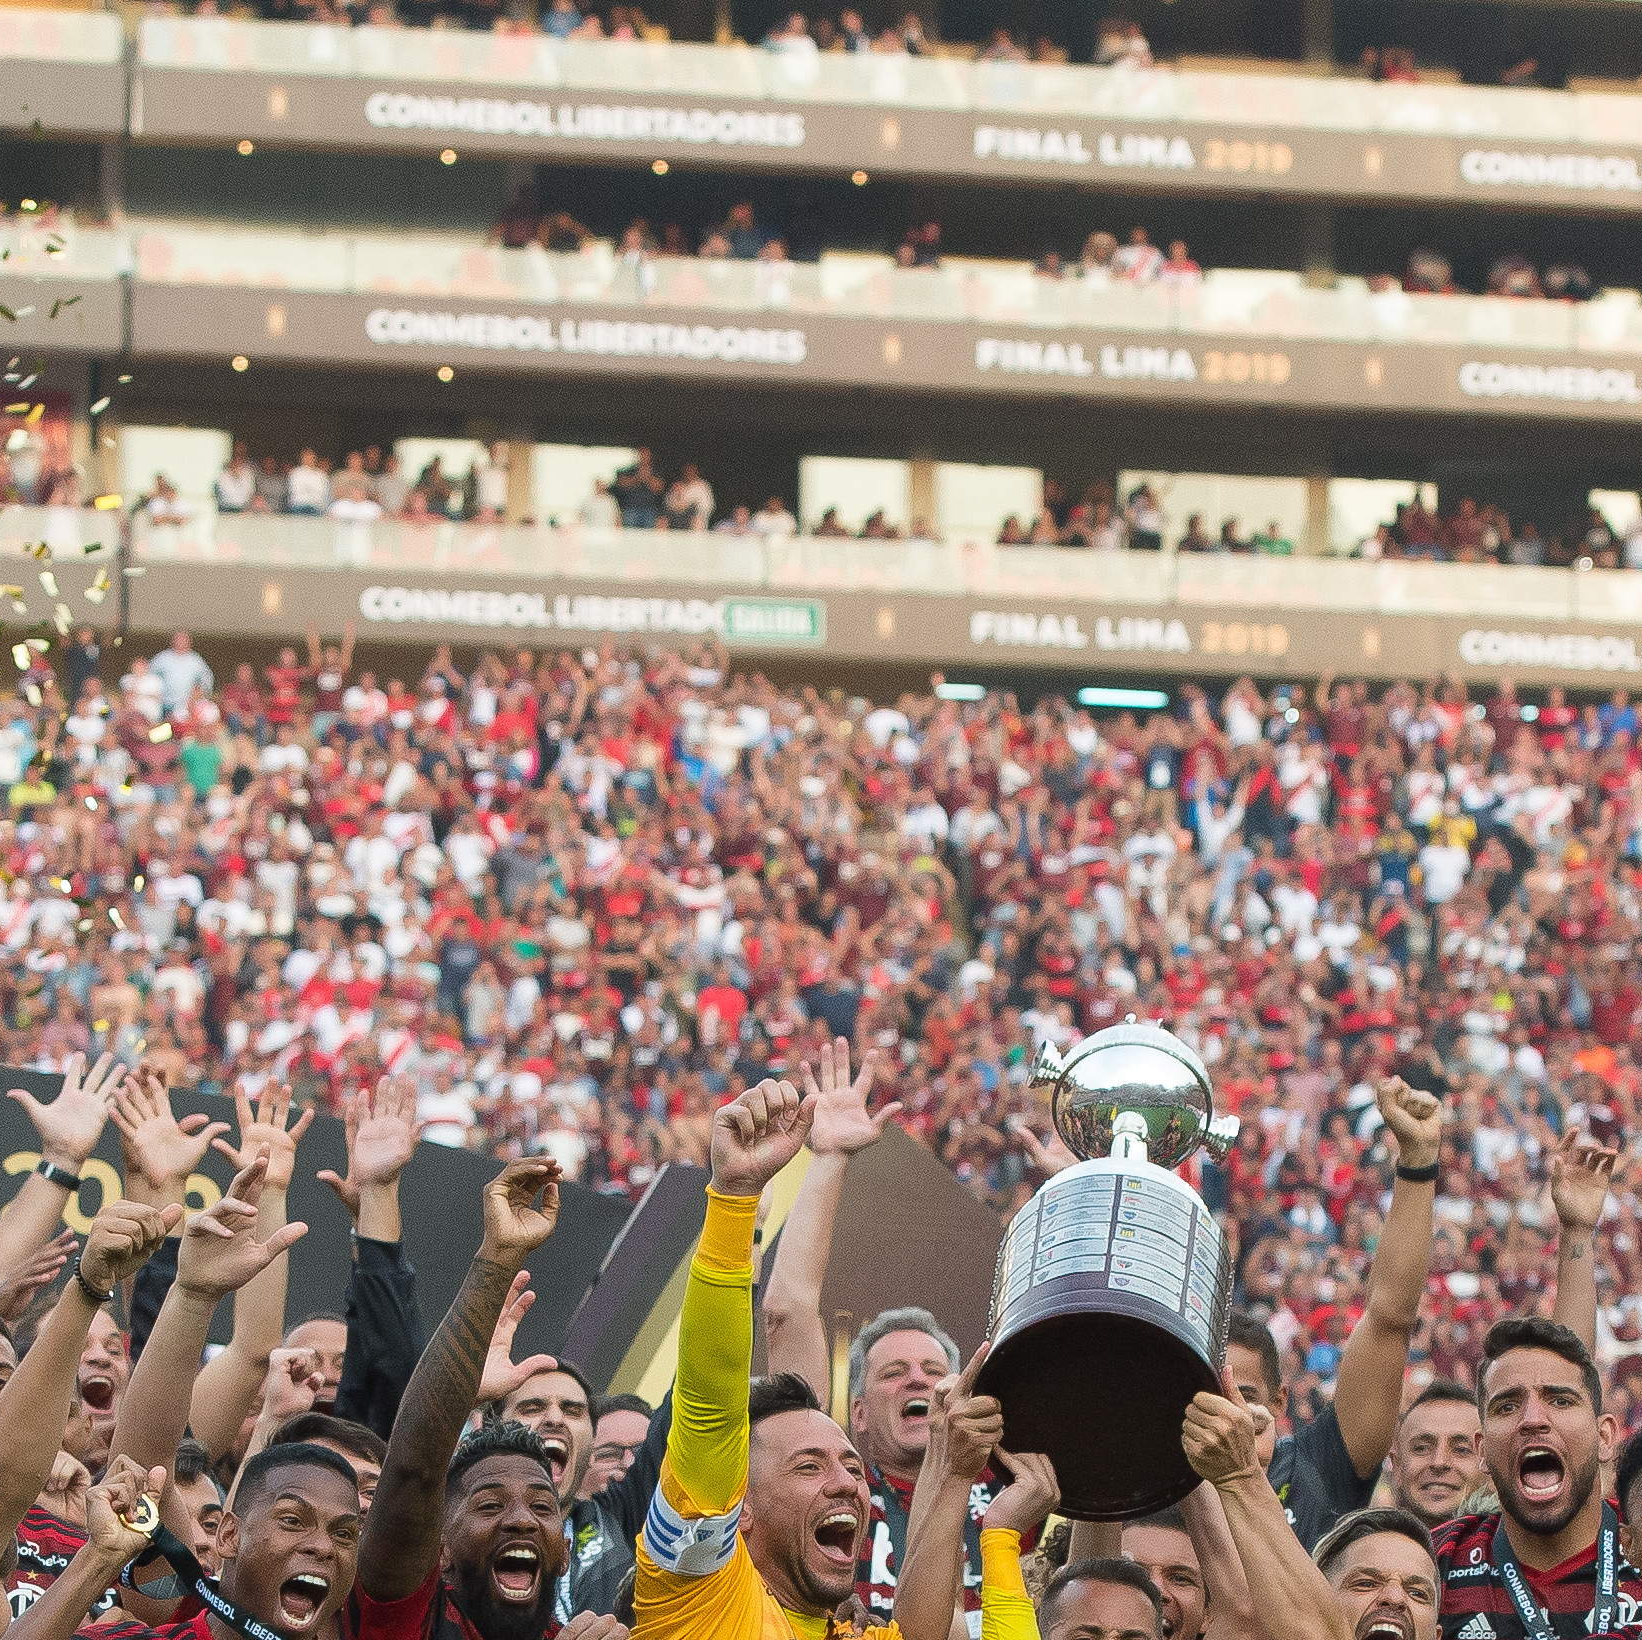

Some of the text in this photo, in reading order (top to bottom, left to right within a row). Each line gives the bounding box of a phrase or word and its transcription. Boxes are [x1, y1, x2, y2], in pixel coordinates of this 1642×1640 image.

[365, 92, 805, 147] CONMEBOL LIBERTADORES
[974, 126, 1091, 164] FINAL
[1099, 132, 1194, 170] LIMA
[365, 308, 807, 365] CONMEBOL LIBERTADORES
[975, 338, 1092, 377] FINAL
[1100, 345, 1197, 381] LIMA
[1459, 362, 1641, 403] CONMEBOL
[359, 585, 554, 629] CONMEBOL
[556, 593, 726, 633] LIBERTADO
[970, 610, 1088, 649] FINAL
[1095, 617, 1190, 653] LIMA
[1459, 629, 1641, 672] CONMEBOL
[1602, 1529, 1614, 1596] LIBERTADORES
[195, 1579, 236, 1621] CONMEBOL
[1503, 1563, 1537, 1623] CONMEBOL
